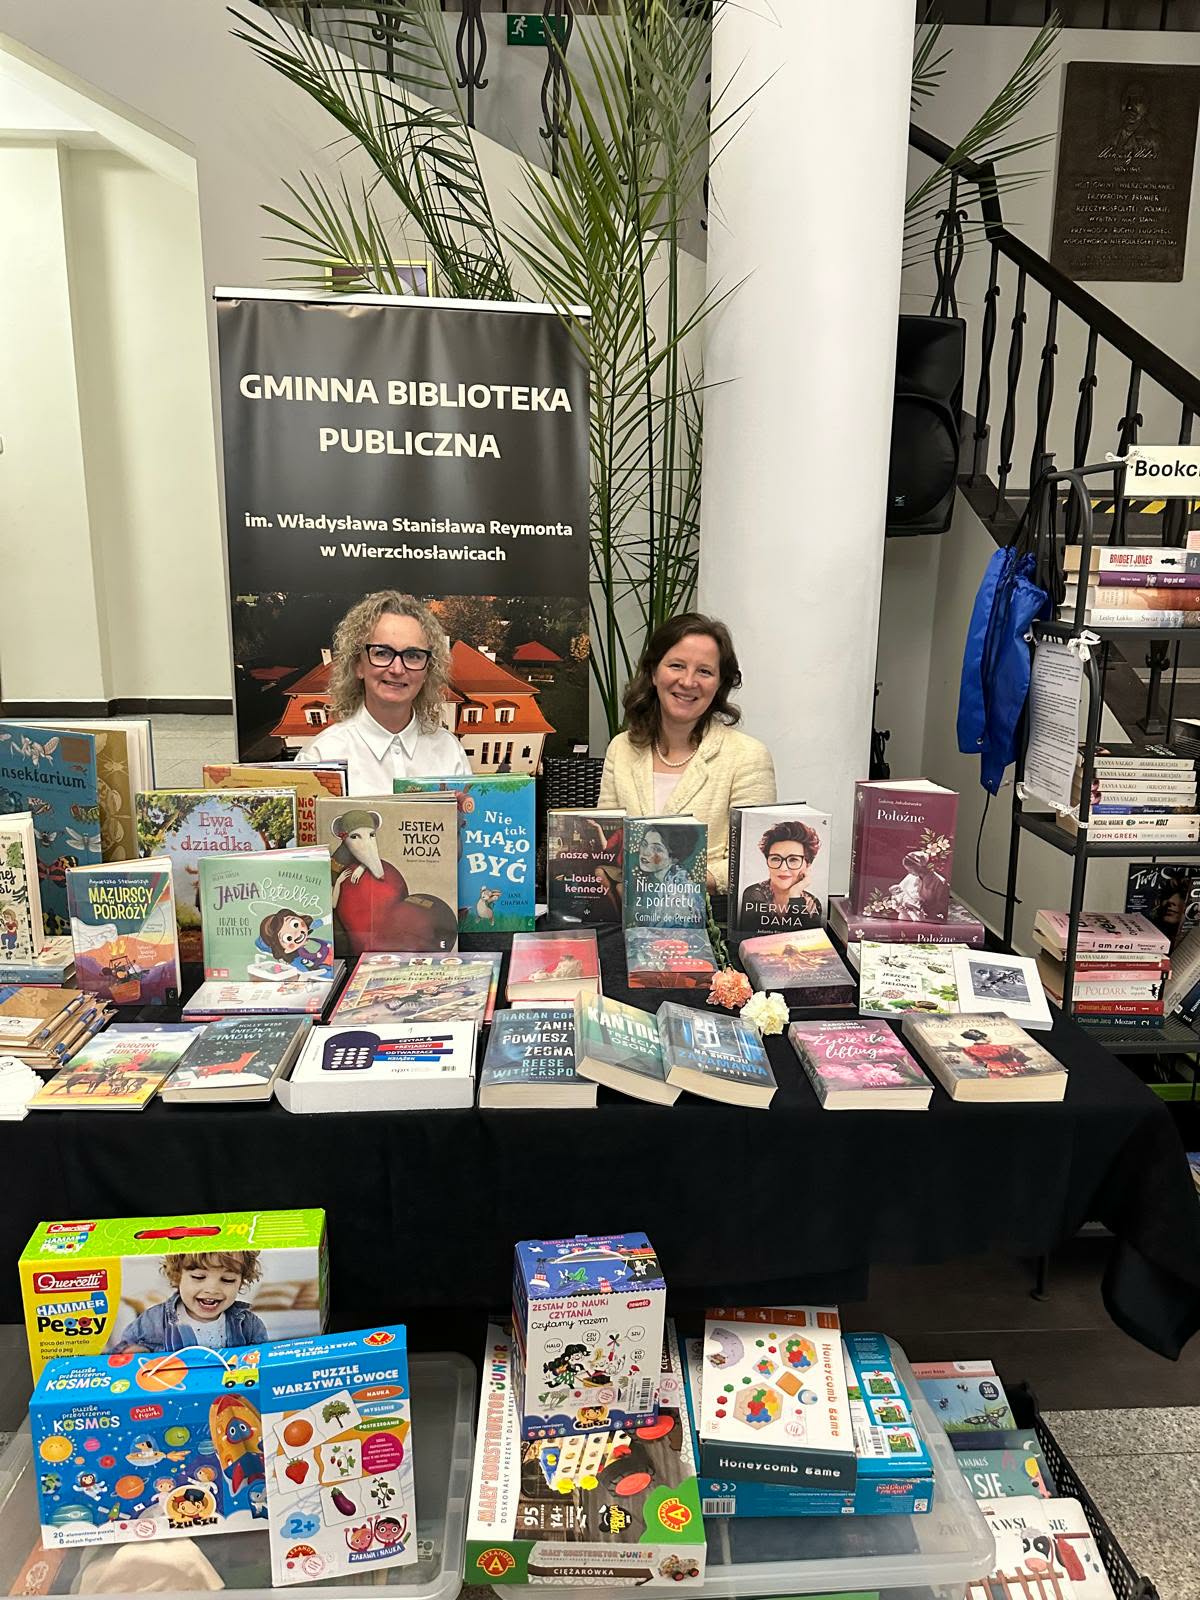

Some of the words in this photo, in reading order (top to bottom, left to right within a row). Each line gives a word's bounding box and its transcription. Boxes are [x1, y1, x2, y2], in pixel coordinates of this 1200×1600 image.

[239, 373, 379, 404] GMINNA
[388, 381, 572, 412] BIBLIOTEKA
[319, 427, 501, 459] PUBLICZNA
[1135, 460, 1200, 477] Bookc
[245, 512, 273, 528] im.
[277, 513, 388, 533] Władysława
[392, 517, 485, 535] Stanisława
[490, 520, 573, 537] Reymonta
[320, 545, 335, 557] w
[341, 542, 506, 561] Wierzchosławicach
[1110, 554, 1132, 563] BRIDGET
[1133, 555, 1152, 564] JONES
[1, 767, 86, 789] nsektarium
[199, 812, 234, 827] Ewa
[484, 811, 513, 824] Nie
[399, 821, 444, 832] JESTEM
[505, 827, 527, 835] tak
[180, 835, 253, 851] dziadka
[403, 833, 440, 844] TYLKO
[465, 830, 530, 854] MIAŁO
[403, 846, 441, 857] MOJA
[560, 851, 588, 859] nasze
[592, 852, 615, 861] winy
[467, 853, 527, 884] BYĆ
[572, 874, 602, 882] louise
[565, 885, 609, 895] kennedy
[636, 877, 701, 894] Nieznajoma
[88, 886, 154, 904] MAZURSCY
[213, 882, 260, 911] JADZIA
[636, 897, 642, 906] z
[647, 895, 693, 908] portretu
[93, 903, 148, 920] PODRÓŻY
[745, 902, 820, 916] PIERWSZA
[219, 917, 238, 927] IDZIE
[239, 917, 249, 926] DO
[635, 913, 660, 922] Camille
[761, 916, 802, 927] DAMA
[216, 927, 252, 937] DENTYSTY
[1085, 986, 1127, 995] POLDARK
[502, 1012, 548, 1020] HARLAN
[502, 1033, 568, 1044] POWIESZ
[608, 1029, 658, 1051] TRZECIA
[814, 1030, 858, 1047] Życie
[864, 1030, 886, 1045] do
[524, 1046, 575, 1057] ŻEGNA
[611, 1037, 655, 1056] OSOBA
[522, 1059, 564, 1067] REESE
[493, 1068, 574, 1078] WITHERSPO
[226, 1224, 249, 1235] 70
[38, 1272, 103, 1290] Quercetti
[37, 1298, 105, 1316] HAMMER
[532, 1303, 565, 1311] ZESTAW
[581, 1299, 609, 1307] NAUKI
[549, 1309, 592, 1319] CZYTANIA
[38, 1316, 107, 1336] Peggy
[531, 1320, 575, 1330] Czytamy
[578, 1317, 608, 1325] razem
[312, 1364, 359, 1380] PUZZLE
[821, 1343, 837, 1402] Honeycomb
[45, 1376, 111, 1392] KOSMOS
[272, 1379, 344, 1397] WARZYWA
[346, 1375, 350, 1385] i
[354, 1369, 399, 1383] OWOCE
[366, 1389, 390, 1397] NAUKA
[62, 1409, 111, 1419] przestrzenne
[72, 1405, 98, 1413] puzzle
[53, 1415, 120, 1433] KOSMOS
[575, 1418, 609, 1429] CzuCzu
[481, 1393, 505, 1480] KONSTRUKTOR
[719, 1458, 798, 1473] Honeycomb
[523, 1506, 539, 1527] 95
[1000, 1517, 1027, 1530] WSI
[290, 1518, 315, 1535] 2+
[351, 1551, 375, 1561] ZABAWA
[380, 1544, 402, 1557] NAUKA
[477, 1548, 515, 1566] ALEXANDER
[620, 1551, 653, 1559] JUNIOR
[554, 1566, 614, 1576] CIĘŻARÓWKA
